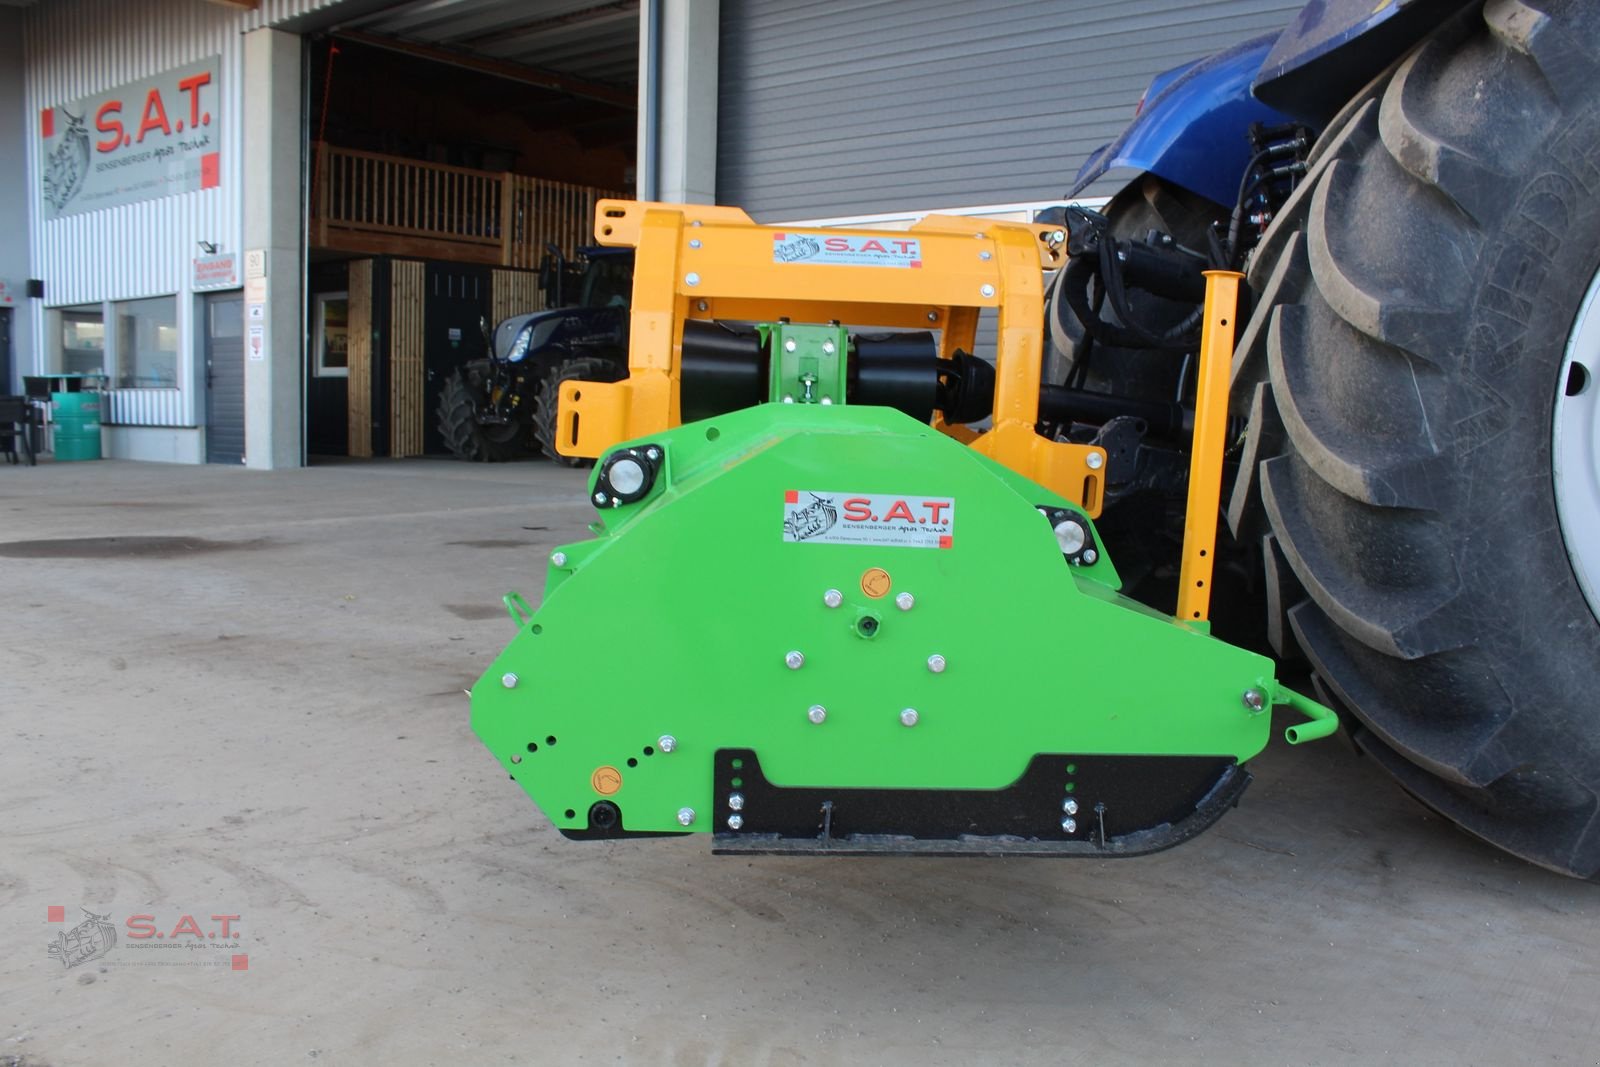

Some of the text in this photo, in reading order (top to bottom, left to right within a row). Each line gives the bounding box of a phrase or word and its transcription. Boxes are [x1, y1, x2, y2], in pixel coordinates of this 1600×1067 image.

[96, 71, 211, 154] S.A.T.
[824, 237, 916, 255] S.A.T.
[842, 497, 949, 525] S.A.T.
